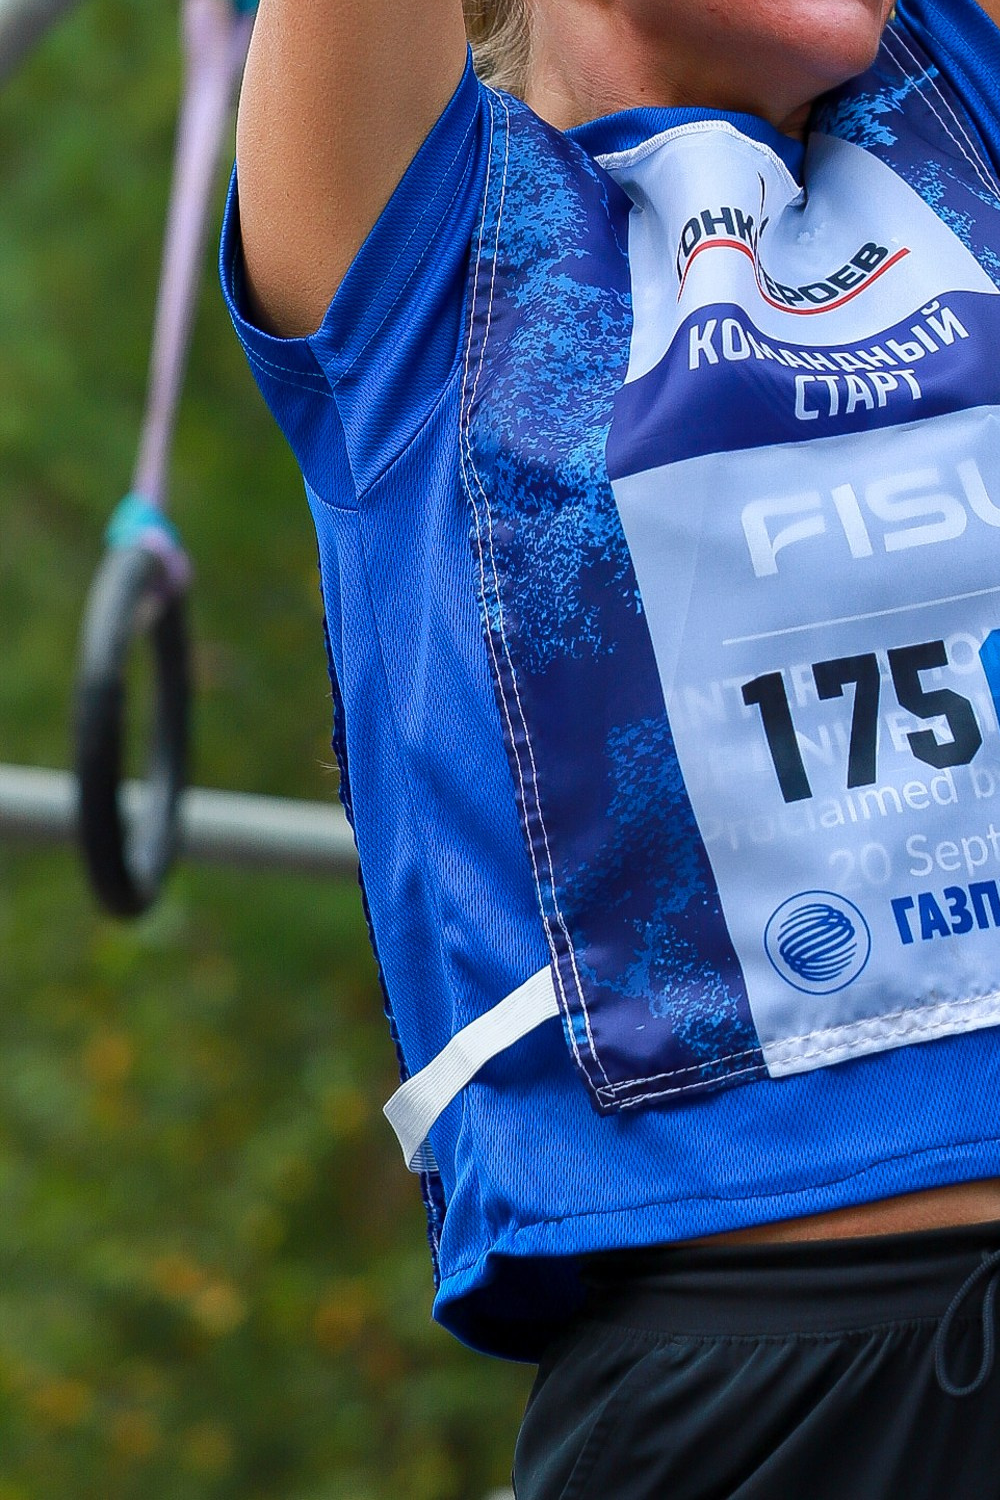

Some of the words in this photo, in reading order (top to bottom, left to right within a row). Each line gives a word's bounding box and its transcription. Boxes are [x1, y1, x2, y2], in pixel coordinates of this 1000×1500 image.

[688, 300, 970, 373] КОМАНДНЫЙ
[795, 368, 922, 420] СТАРТ
[828, 840, 892, 892] 20
